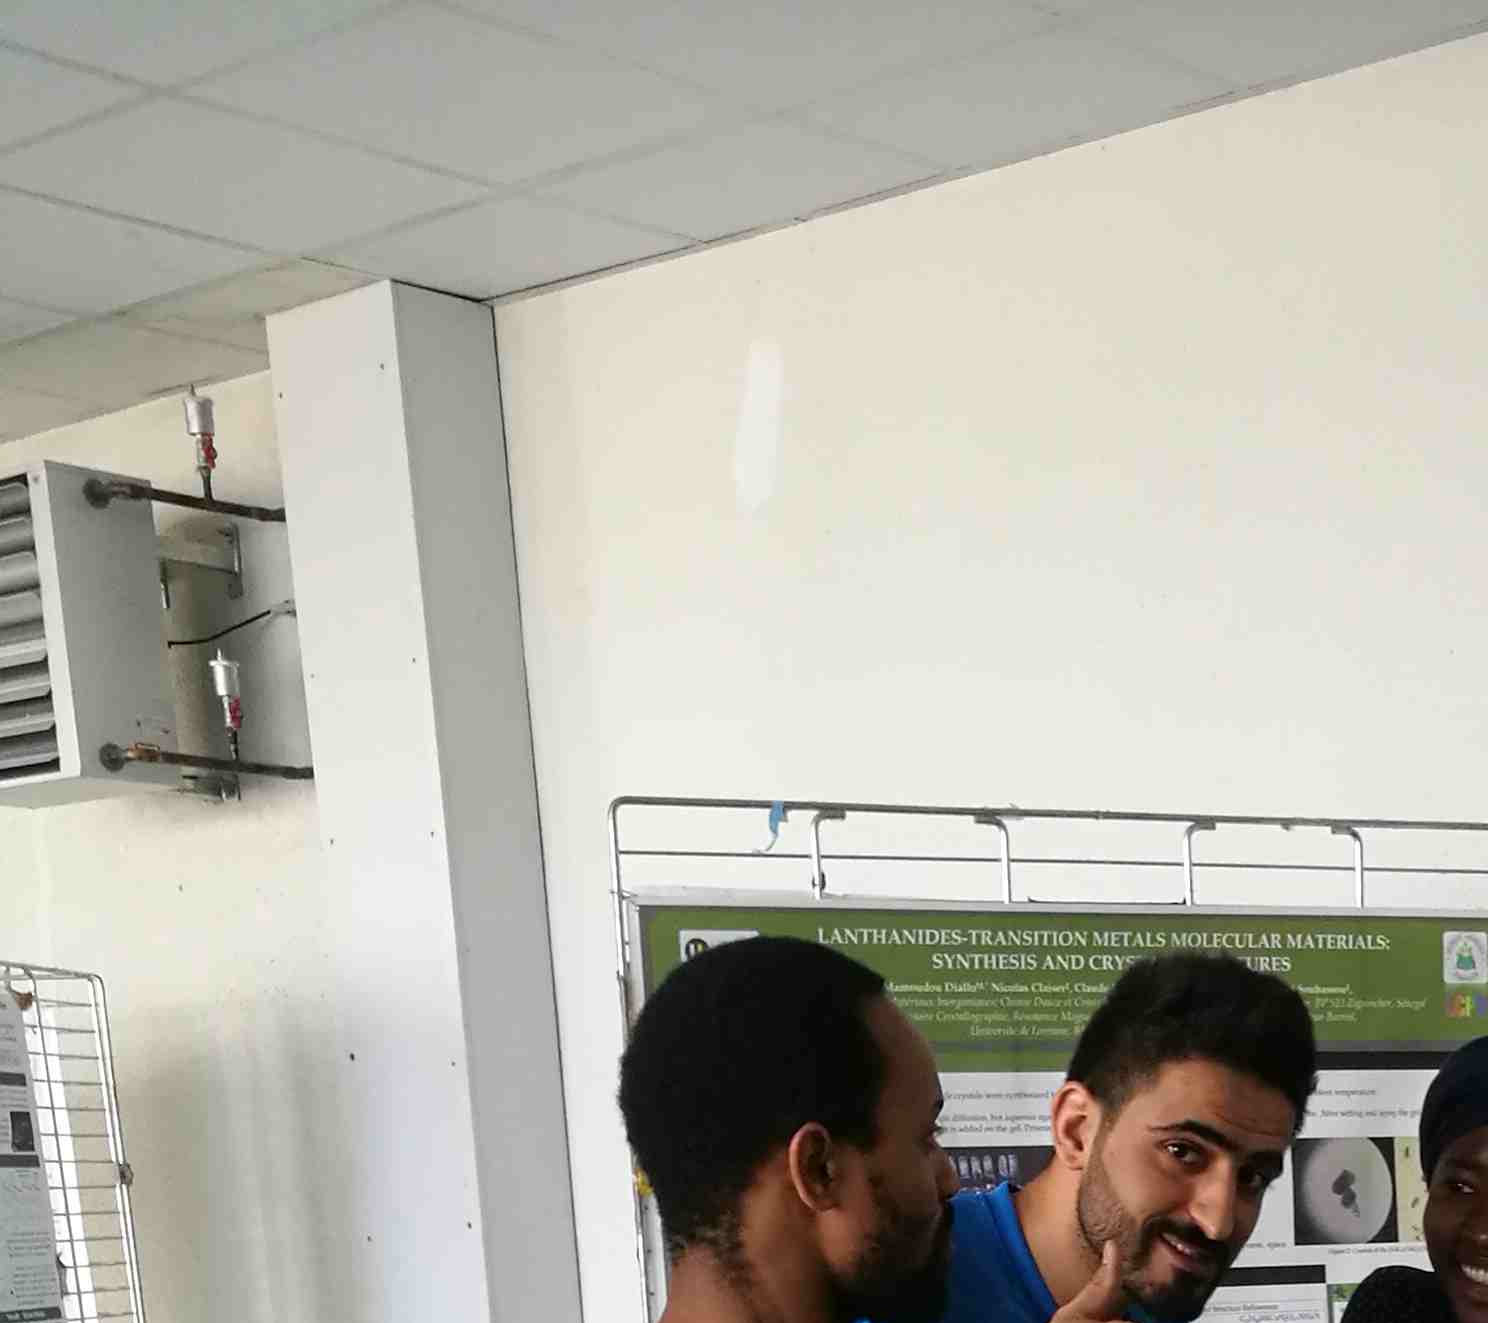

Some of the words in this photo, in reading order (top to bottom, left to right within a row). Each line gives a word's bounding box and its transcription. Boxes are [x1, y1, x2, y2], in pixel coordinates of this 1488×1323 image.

[817, 927, 1087, 947] LANTHANIDES-TRANSITION
[1092, 931, 1166, 949] METALS
[1170, 932, 1282, 950] MOLECULAR
[1287, 934, 1391, 950] MATERIALS:
[932, 953, 1037, 970] SYNTHESIS
[1042, 954, 1085, 971] AND
